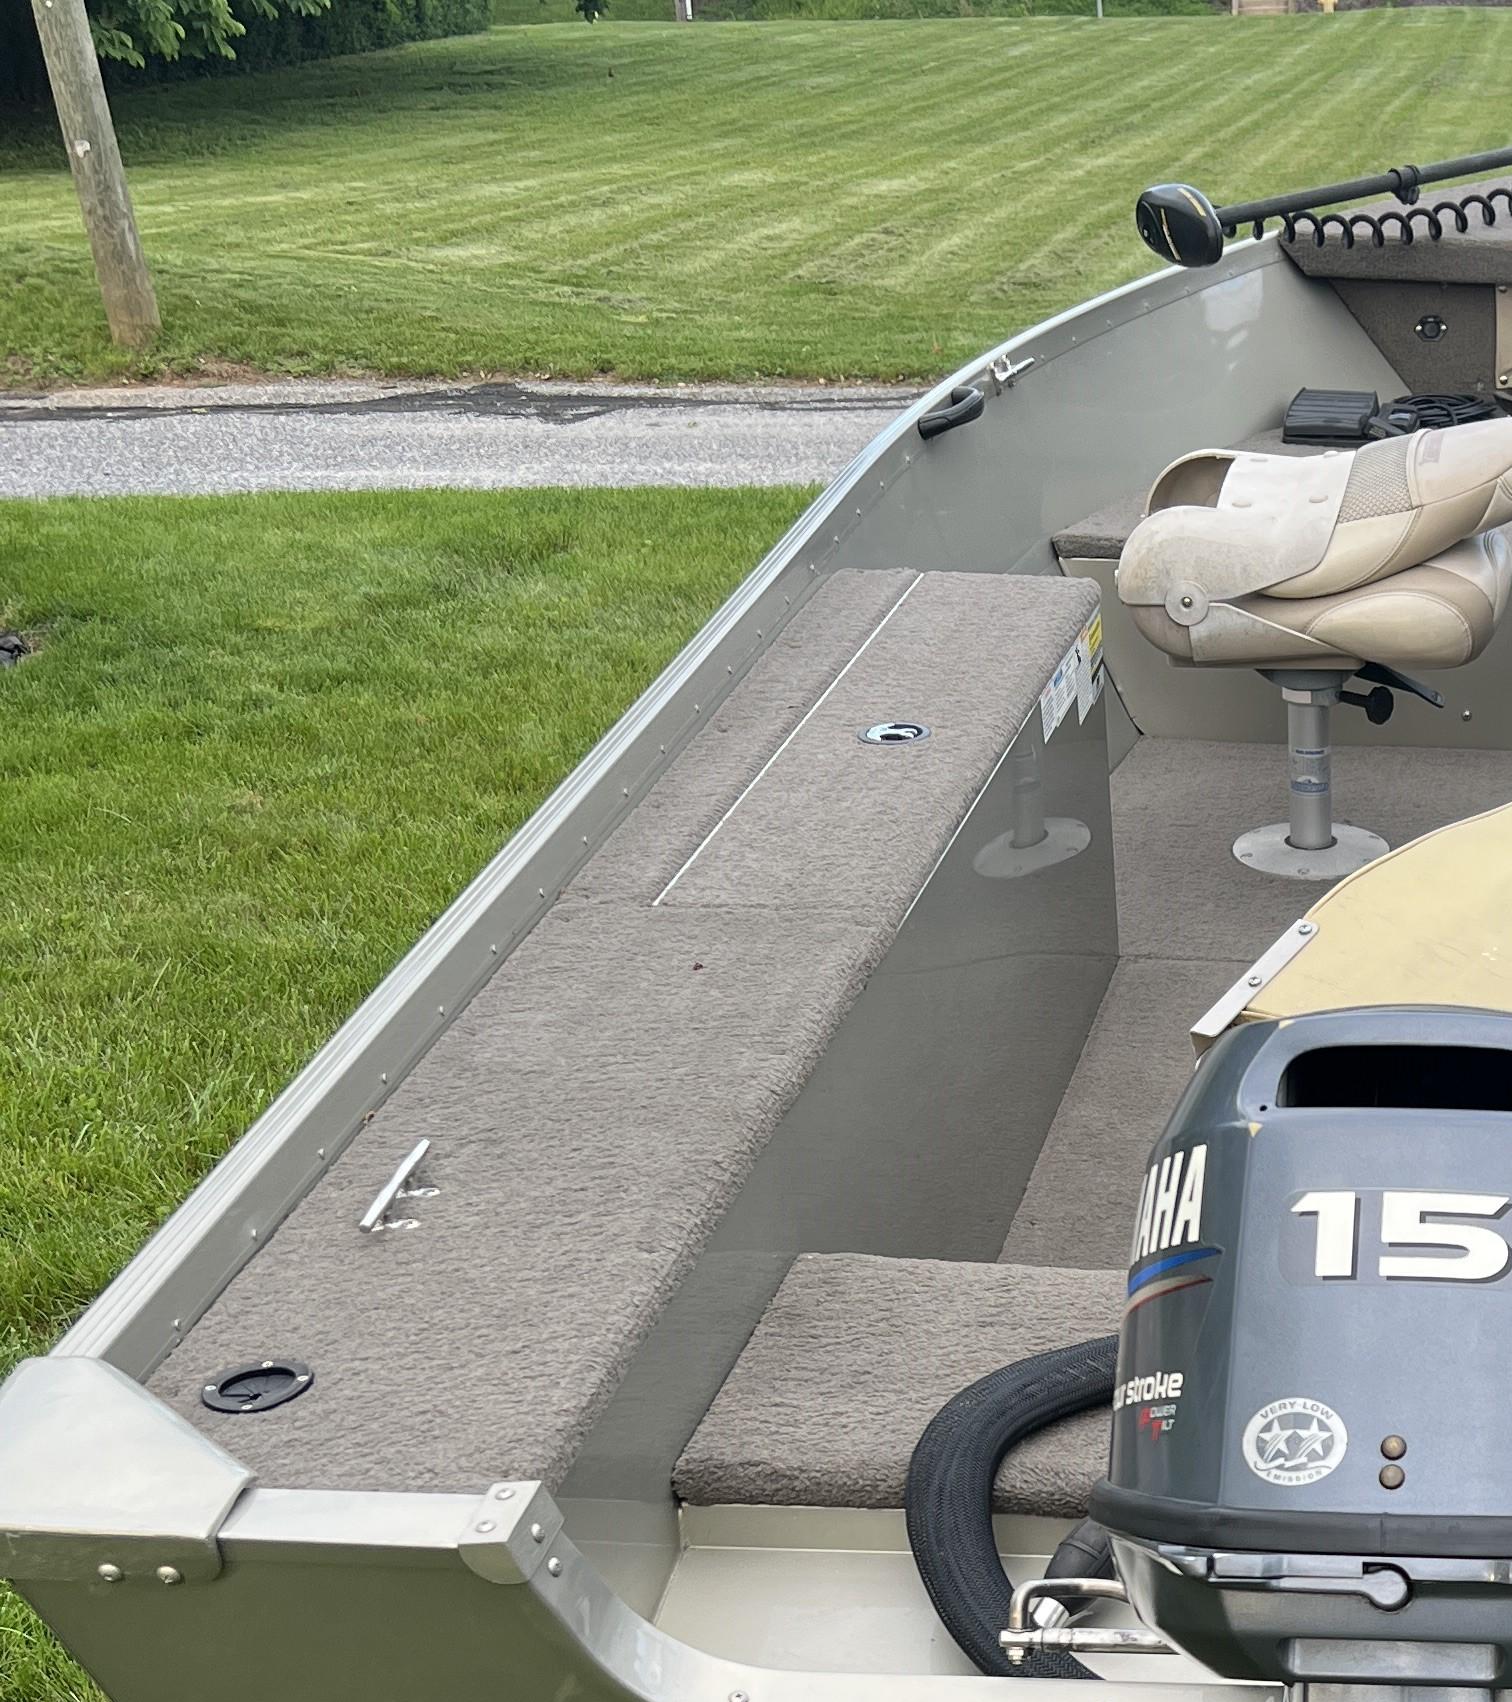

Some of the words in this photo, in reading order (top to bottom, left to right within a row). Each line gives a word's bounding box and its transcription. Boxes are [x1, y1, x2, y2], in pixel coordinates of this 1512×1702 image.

[1129, 1143, 1207, 1266] AHA
[1125, 1371, 1184, 1405] stroke
[1260, 1400, 1297, 1421] VERY
[1302, 1401, 1334, 1421] LOW
